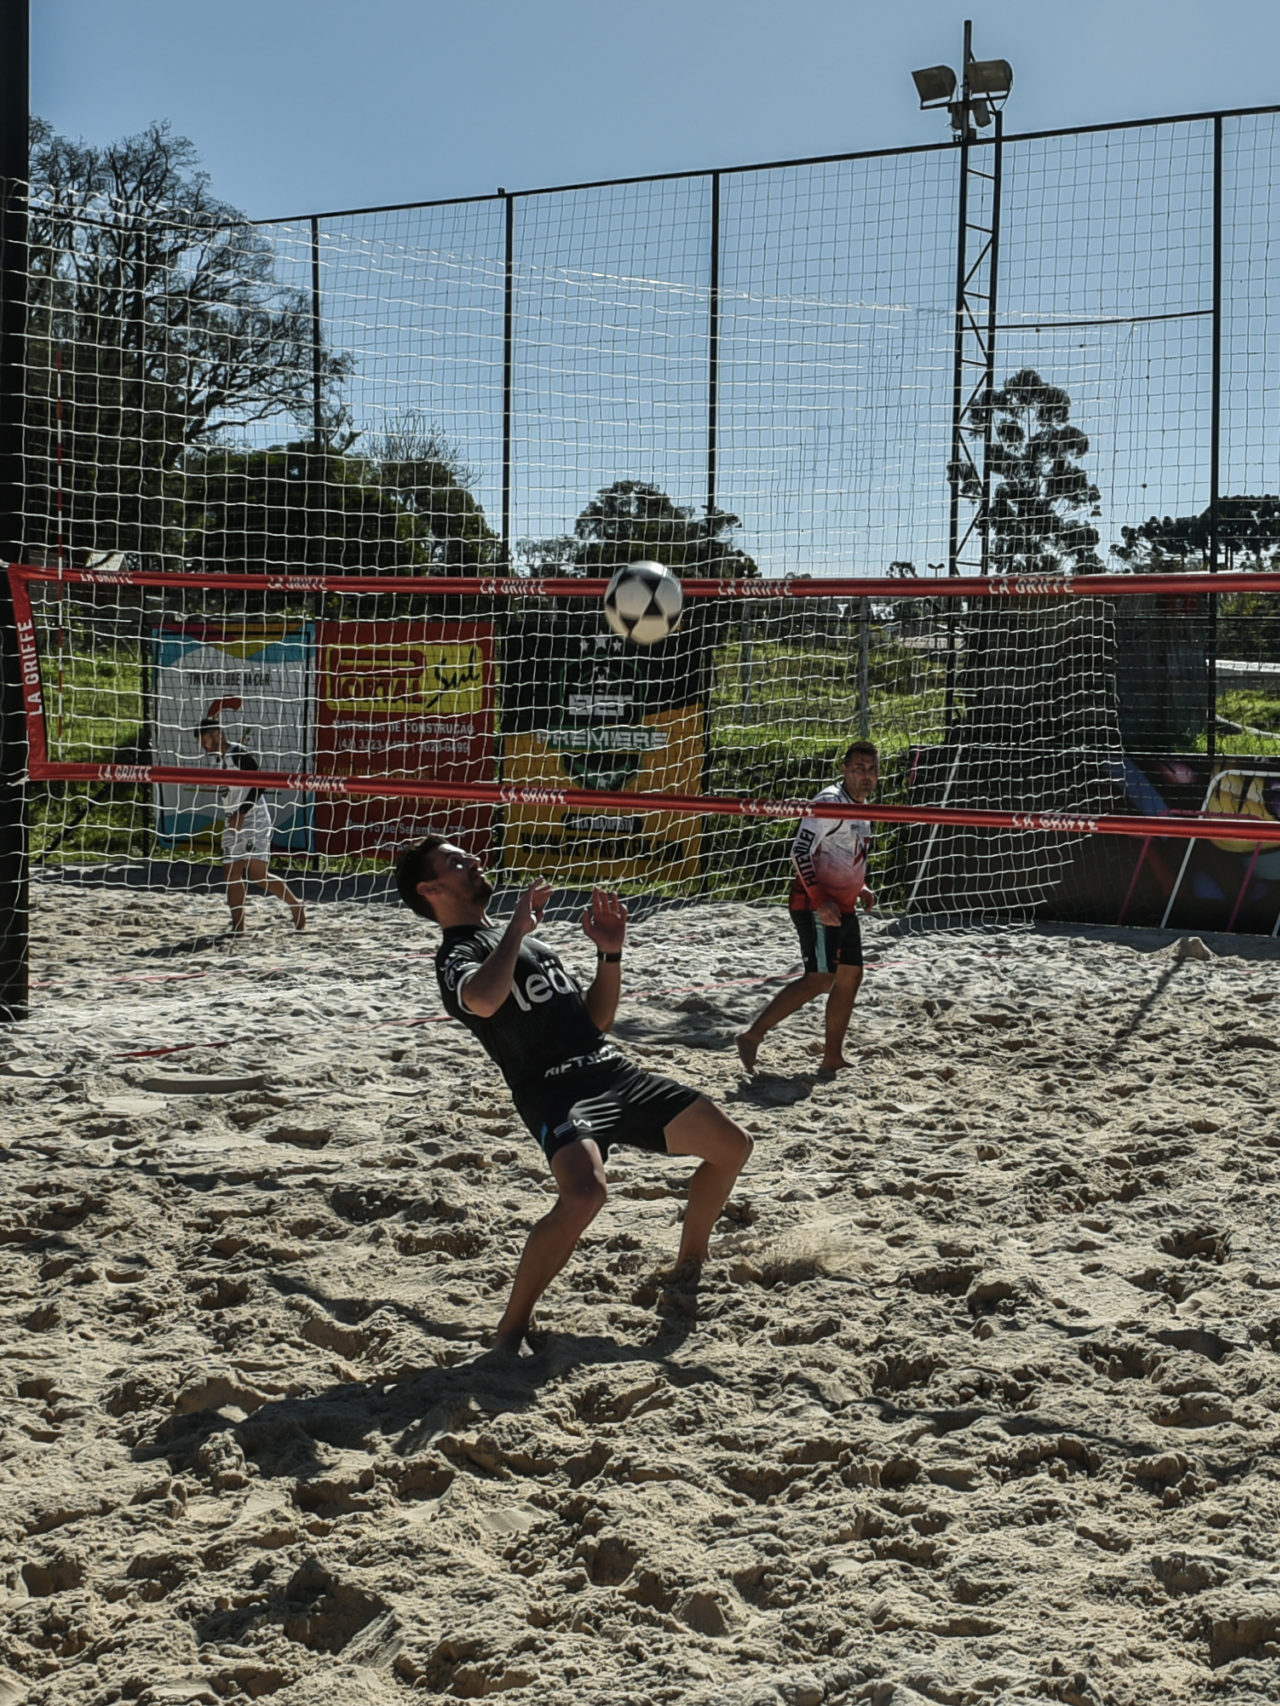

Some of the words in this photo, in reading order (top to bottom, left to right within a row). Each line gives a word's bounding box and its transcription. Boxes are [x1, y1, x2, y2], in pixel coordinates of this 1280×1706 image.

[717, 579, 737, 596] LA
[741, 579, 794, 596] GRIFFE
[988, 578, 1010, 595] LA
[1014, 577, 1075, 594] GRIFFE
[17, 619, 39, 685] GRIFFE
[27, 691, 43, 716] LA
[406, 721, 475, 737] CONSTRUÇÃO
[98, 765, 110, 781] LA
[114, 765, 153, 783] GRIFFE
[500, 786, 517, 802] LA
[520, 787, 567, 804] GRIFFE
[1012, 813, 1034, 829] LA
[1038, 815, 1099, 831] GRIFFE
